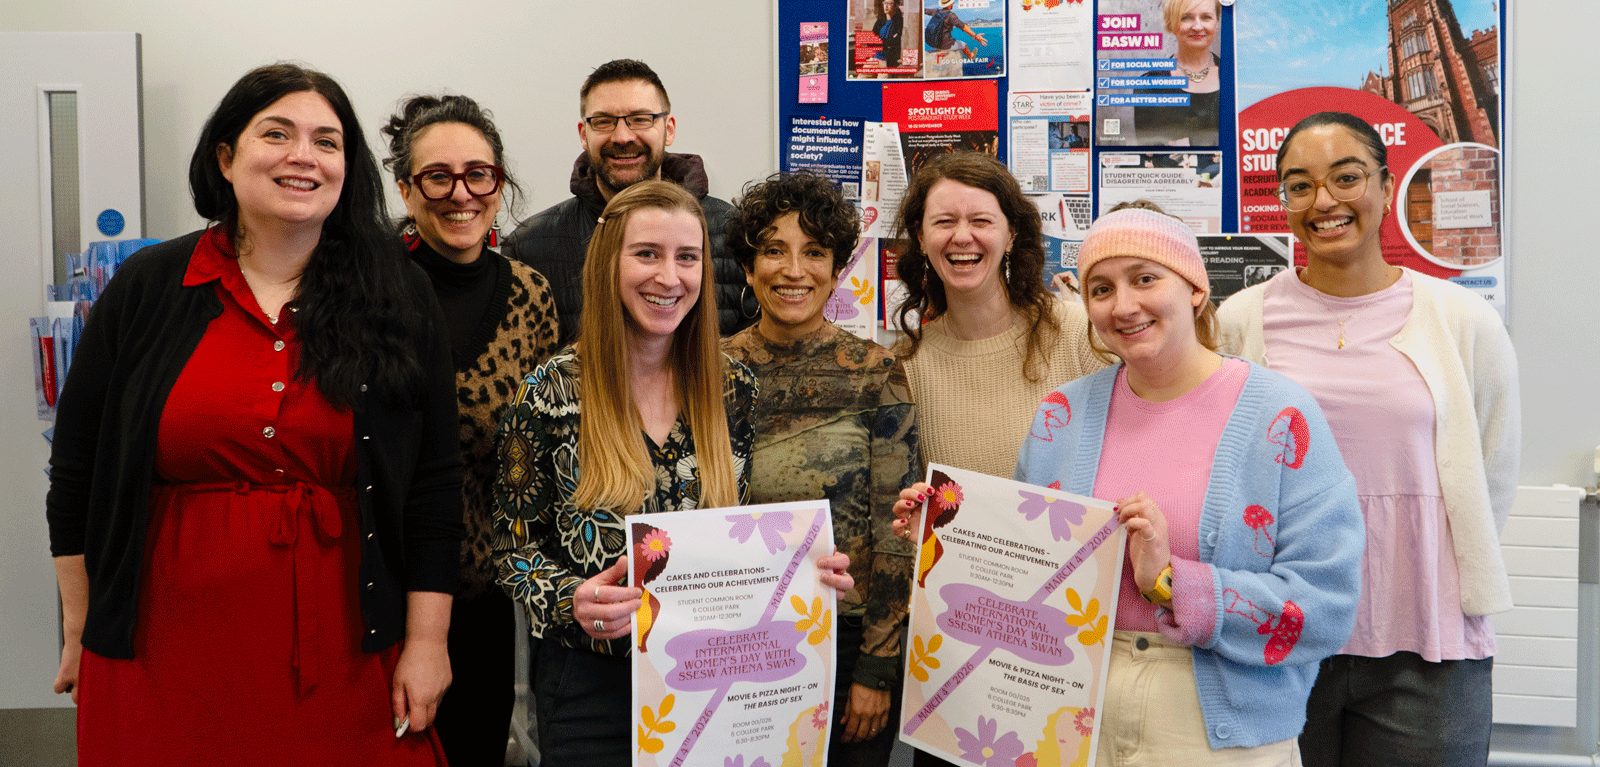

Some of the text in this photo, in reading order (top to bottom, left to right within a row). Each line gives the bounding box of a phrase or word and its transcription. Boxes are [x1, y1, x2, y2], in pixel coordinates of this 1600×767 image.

[1101, 16, 1137, 28] JOIN
[1102, 36, 1160, 48] BASW NI
[908, 107, 972, 116] SPOTLIGHT ON
[792, 118, 832, 126] Interested
[842, 119, 859, 127] how
[792, 127, 850, 135] documentaries
[792, 135, 852, 144] might influence
[1242, 127, 1290, 151] SOC
[790, 153, 824, 161] society?
[806, 145, 848, 153] perception
[1244, 175, 1278, 184] RECRUITI
[1244, 188, 1276, 197] ACADEM
[1041, 212, 1056, 221] RK
[952, 527, 1046, 556] CAKES AND CELEBRATIONS
[941, 534, 1060, 570] CELEBRATING OUR ACHIEVEMENTS
[1045, 563, 1076, 594] MARCH
[1087, 526, 1112, 551] 2026
[770, 569, 795, 610] MARCH
[802, 523, 820, 552] 2026
[958, 553, 1029, 576] STUDENT COMMON ROOM
[976, 565, 999, 578] COLLEGE
[1000, 572, 1014, 581] PARK
[666, 566, 765, 582] CAKES AND CELEBRATIONS
[655, 575, 780, 594] CELEBRATING OUR ACHIEVEMENTS
[678, 594, 754, 606] STUDENT COMMON ROOM
[977, 596, 1039, 620] CELEBRATE
[698, 605, 723, 614] COLLEGE
[965, 602, 1050, 633] INTERNATIONAL
[954, 609, 1059, 646] WOMEN'S DAY WITH
[707, 630, 770, 648] CELEBRATE
[948, 618, 1063, 658] SSESW ATHENA SWAN
[695, 640, 781, 659] INTERNATIONAL
[684, 648, 791, 670] WOMEN'S DAY WITH
[678, 657, 796, 682] SSESW ATHENA SWAN
[989, 658, 1012, 671] MOVIE
[1019, 667, 1040, 679] PIZZA
[1041, 672, 1065, 686] NIGHT
[1072, 680, 1085, 690] ON
[917, 695, 944, 722] MARCH
[952, 662, 975, 685] 2026
[990, 686, 1008, 697] ROOM
[1003, 672, 1066, 696] THE BASIS OF SEX
[727, 693, 751, 703] MOVIE
[759, 688, 780, 699] PIZZA
[780, 685, 802, 696] NIGHT
[744, 695, 803, 712] THE BASIS OF SEX
[992, 695, 1016, 706] COLLEGE
[1016, 701, 1032, 712] PARK
[692, 708, 714, 738] 2026
[736, 727, 760, 736] COLLEGE
[761, 724, 775, 732] PARK
